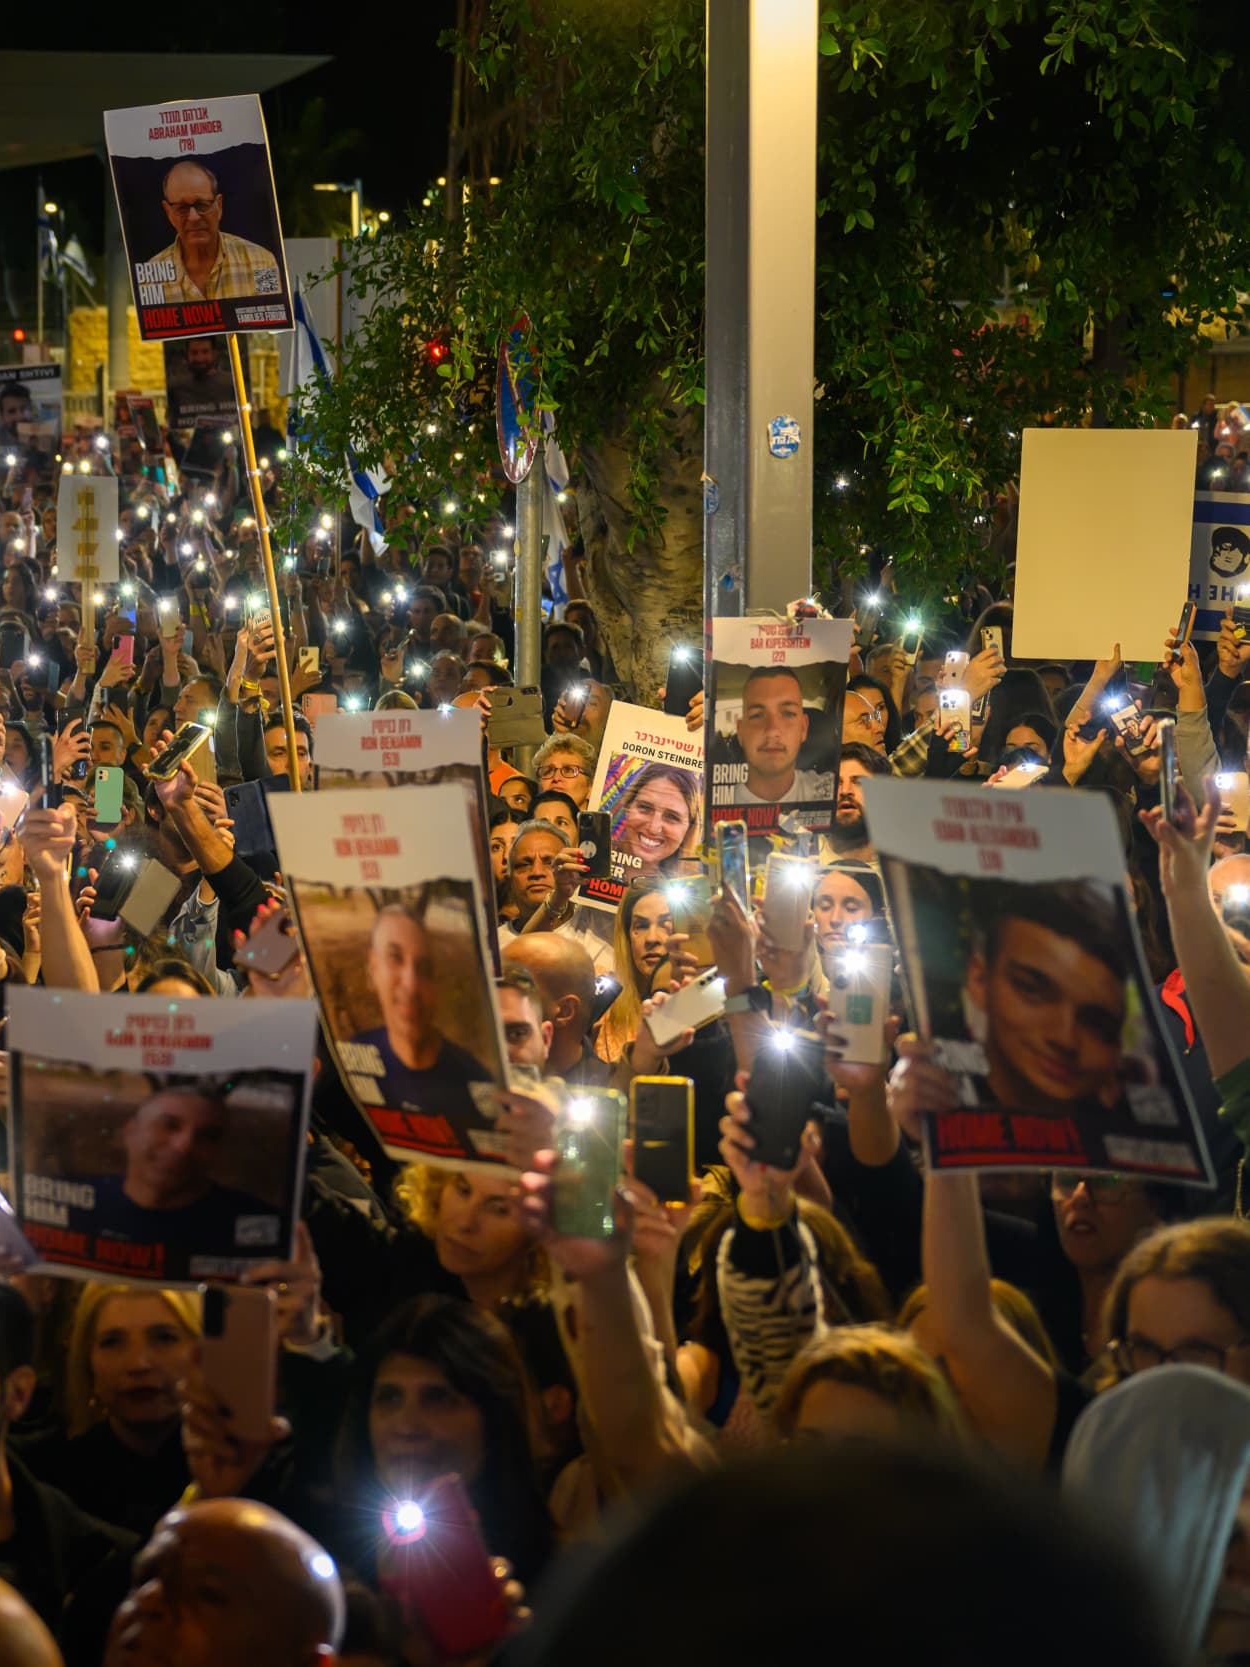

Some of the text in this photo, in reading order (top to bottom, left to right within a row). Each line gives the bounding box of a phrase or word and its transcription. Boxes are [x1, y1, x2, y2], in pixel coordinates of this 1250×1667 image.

[182, 106, 208, 121] אברהם
[148, 120, 223, 141] ABRAHAM MUNDER
[179, 138, 195, 153] (78)
[135, 261, 177, 284] BRING
[138, 284, 165, 306] HIM
[142, 301, 223, 329] HOME NOW!
[750, 638, 763, 649] BAR
[361, 735, 422, 750] RON BENJAMIN
[635, 730, 695, 754] שטיינברכר
[622, 741, 656, 758] DORON
[657, 750, 704, 769] STEINBRE
[712, 762, 749, 785] BRING
[712, 785, 735, 806] HIM
[747, 804, 781, 827] NOW!
[611, 850, 642, 869] RING
[610, 865, 625, 879] ER
